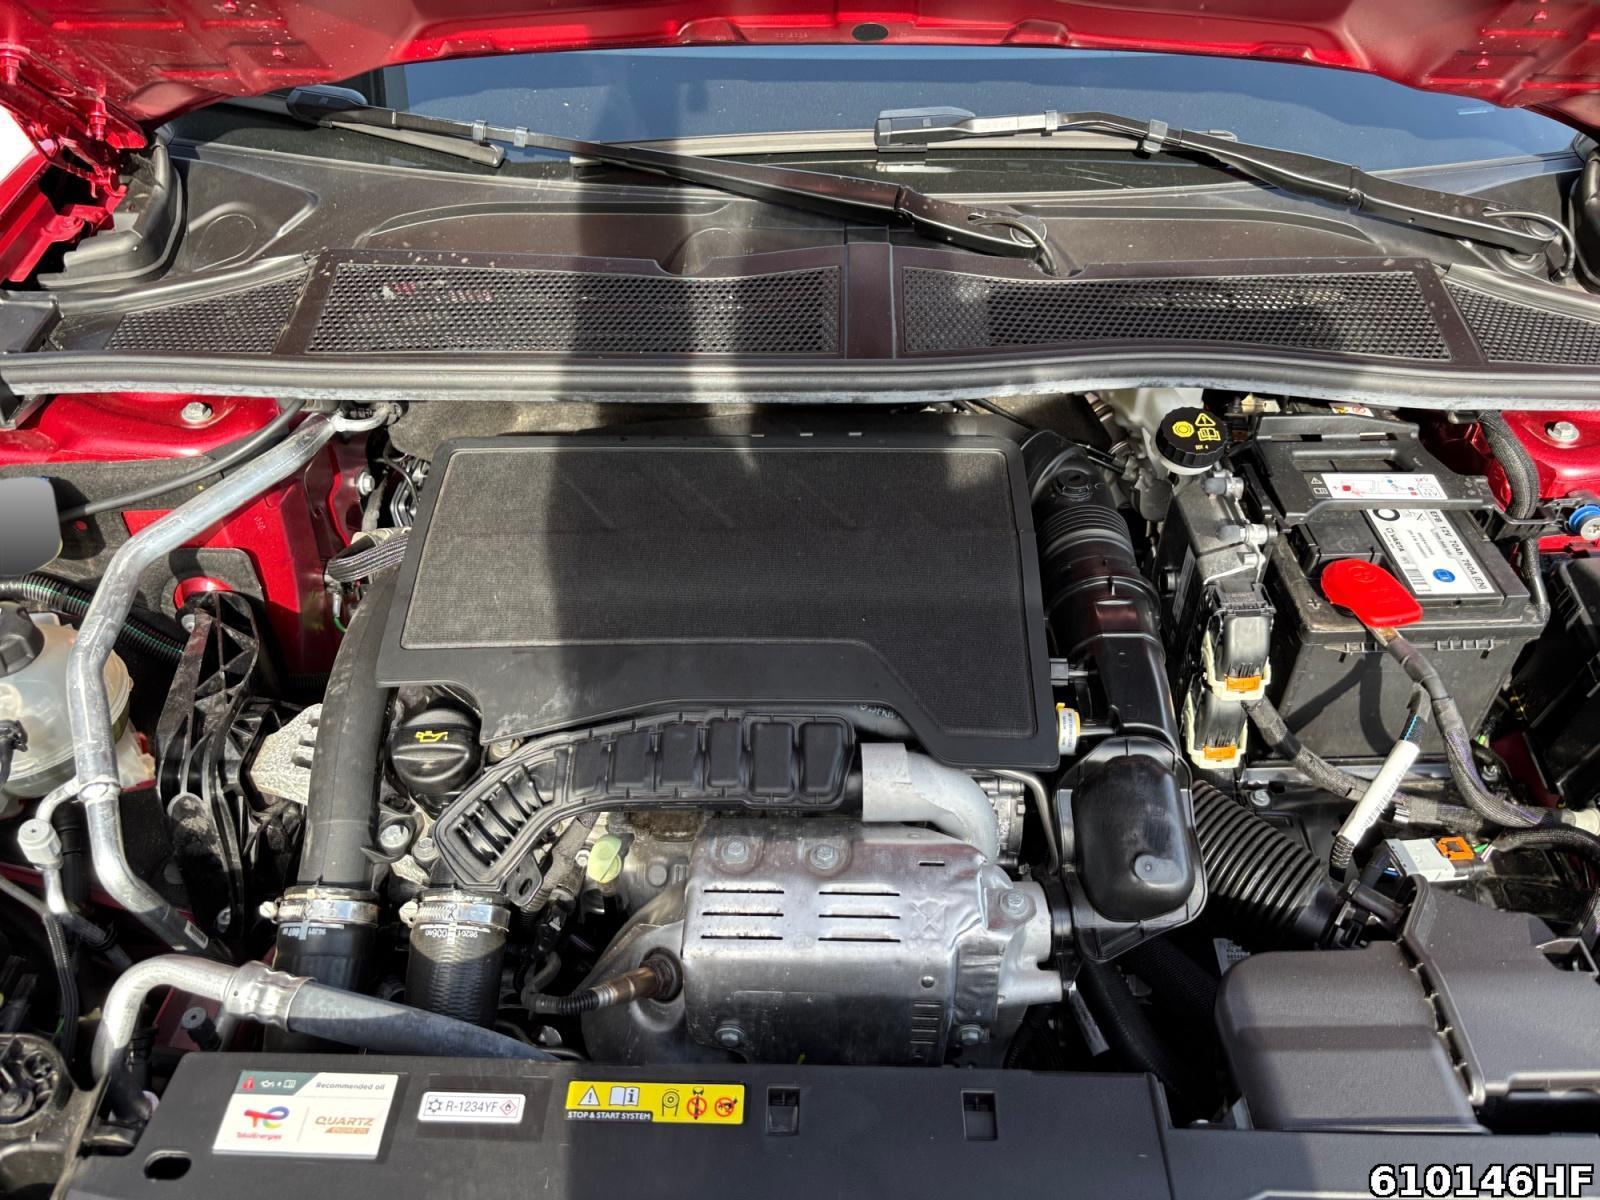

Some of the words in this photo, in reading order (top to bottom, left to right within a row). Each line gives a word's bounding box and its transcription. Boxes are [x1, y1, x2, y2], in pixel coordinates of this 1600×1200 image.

[1440, 526, 1453, 537] 12V
[315, 1082, 373, 1090] Recommended
[445, 1101, 499, 1113] R-1234YF
[315, 1115, 375, 1126] QUARTZ
[567, 1111, 588, 1119] STOP
[596, 1112, 620, 1120] START
